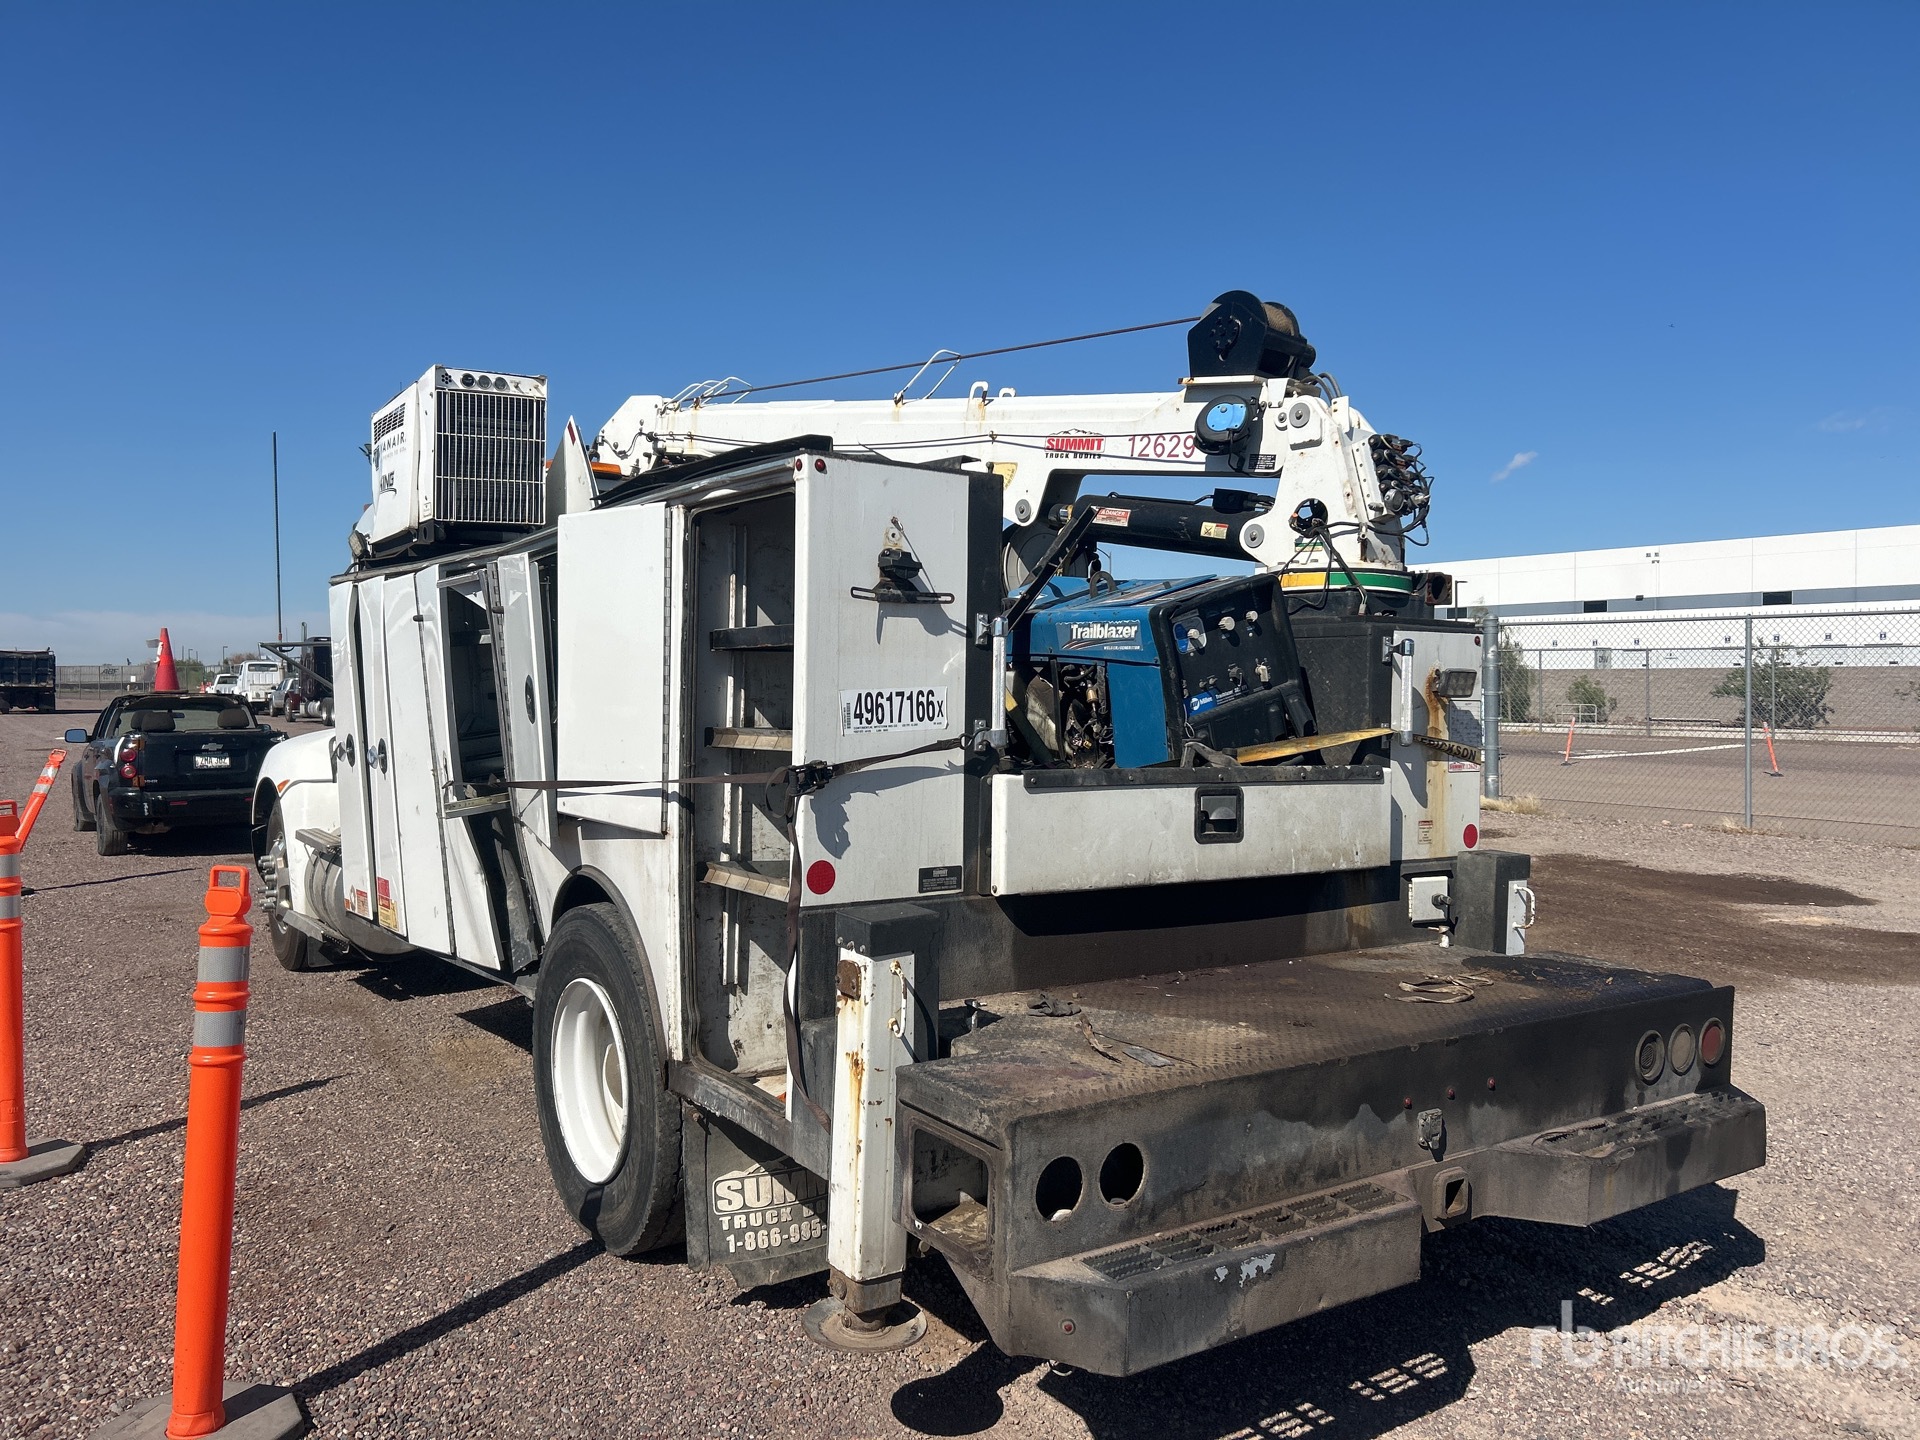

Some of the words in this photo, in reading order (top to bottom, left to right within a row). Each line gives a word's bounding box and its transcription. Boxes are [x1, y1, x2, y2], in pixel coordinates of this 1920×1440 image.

[1046, 437, 1104, 451] SUMMIT
[1127, 434, 1196, 459] 12629
[1070, 623, 1138, 640] Trailblazer
[719, 1207, 793, 1231] TRUCK
